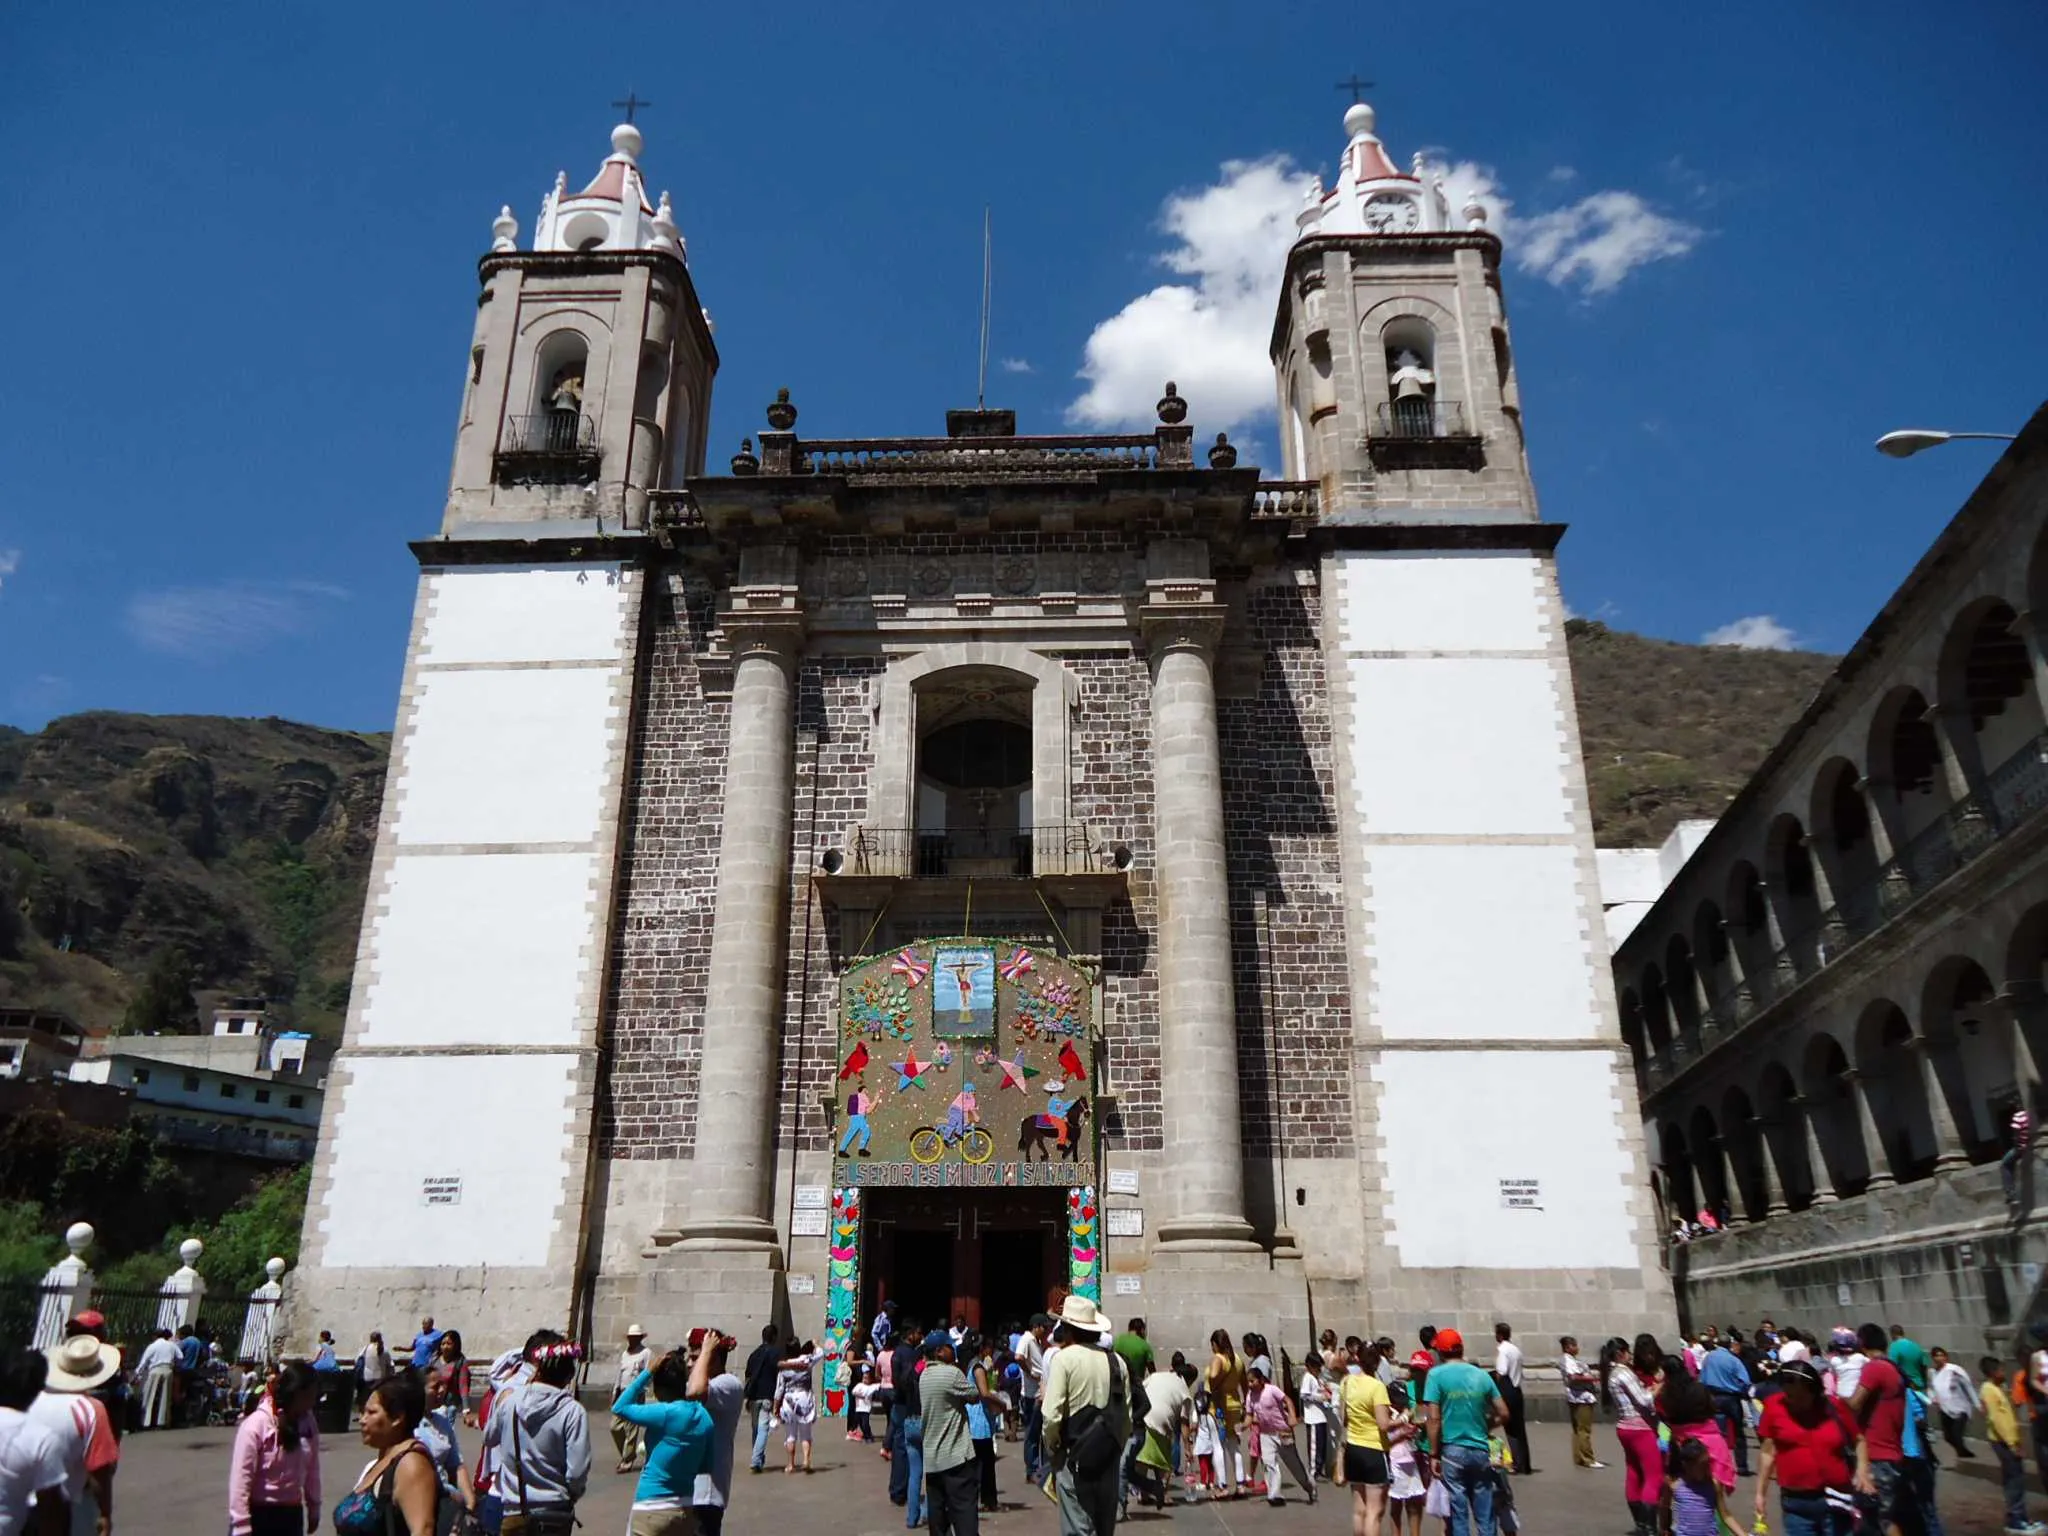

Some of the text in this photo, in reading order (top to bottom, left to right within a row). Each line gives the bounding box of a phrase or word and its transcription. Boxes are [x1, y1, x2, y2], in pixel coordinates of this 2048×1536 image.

[836, 1163, 853, 1186] EL
[918, 1163, 939, 1186] ES
[945, 1163, 968, 1186] MI
[968, 1163, 996, 1186] LUZ
